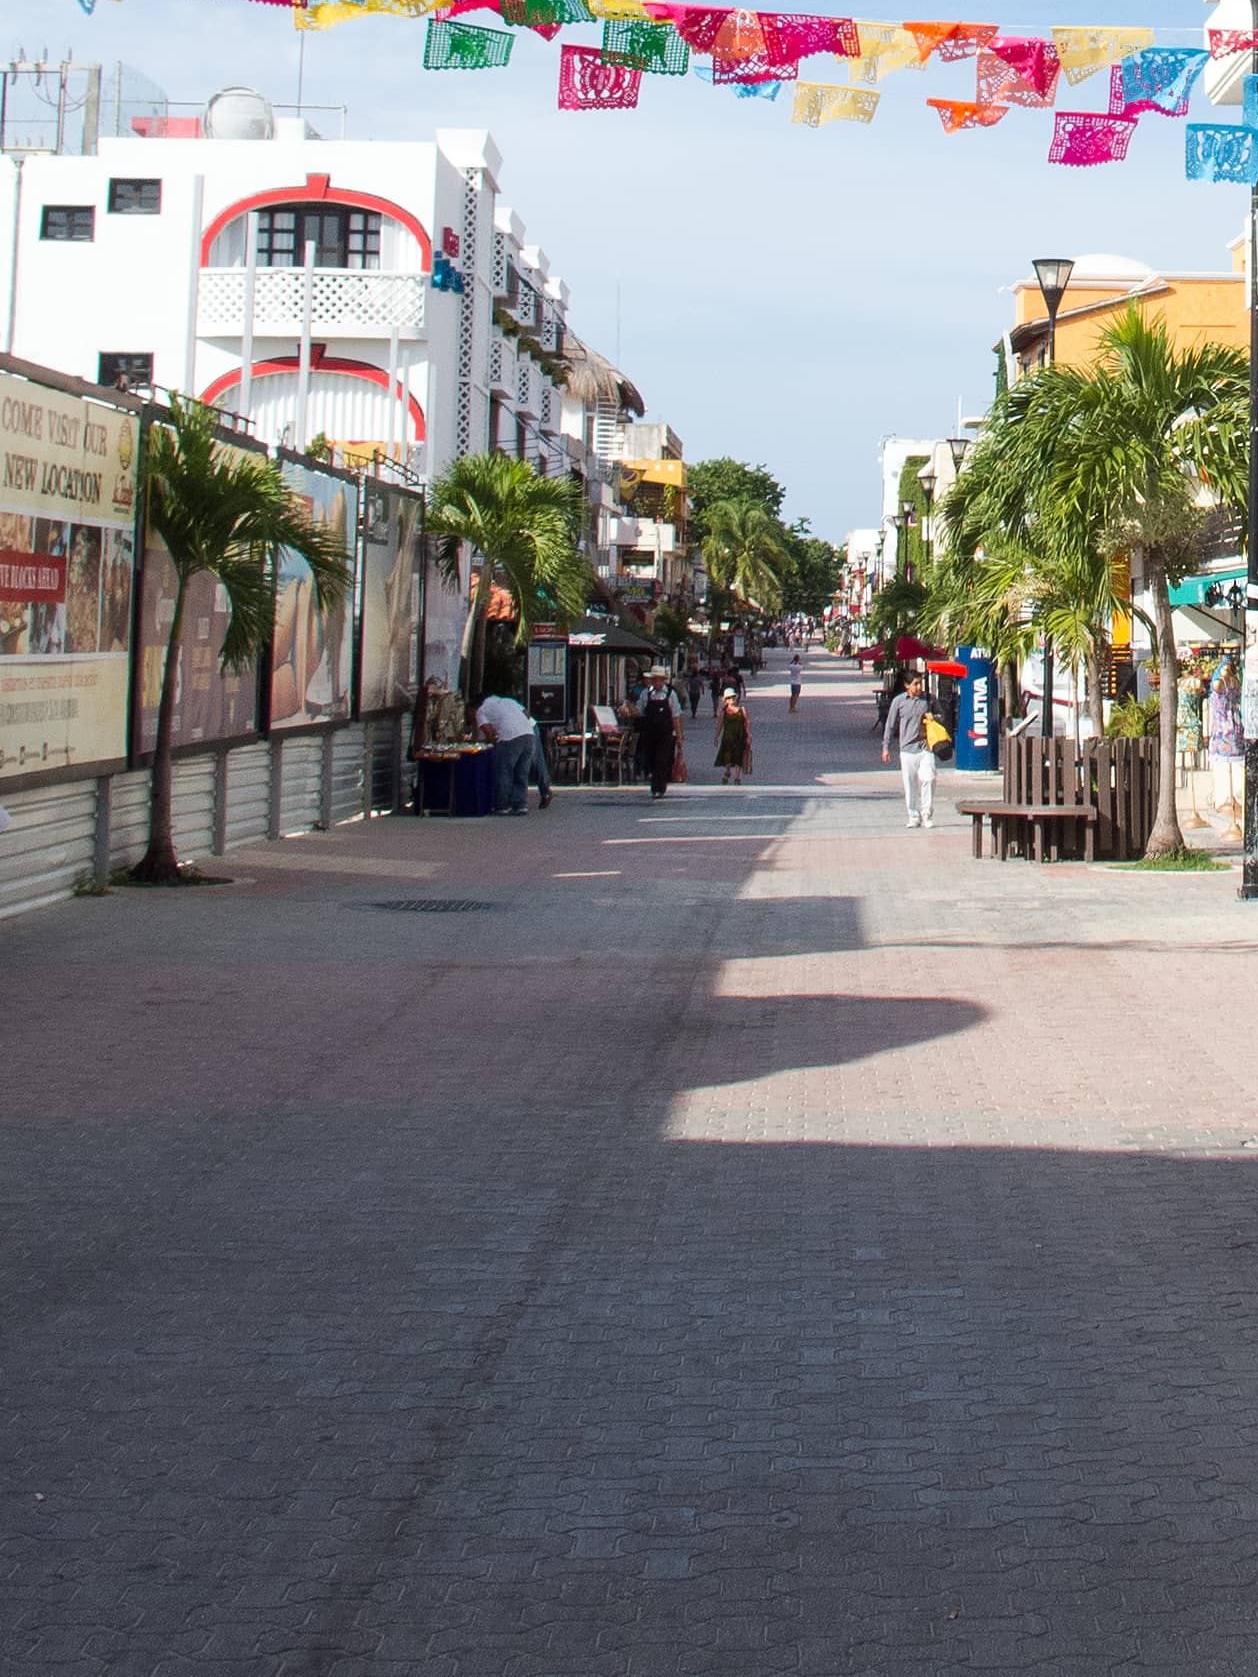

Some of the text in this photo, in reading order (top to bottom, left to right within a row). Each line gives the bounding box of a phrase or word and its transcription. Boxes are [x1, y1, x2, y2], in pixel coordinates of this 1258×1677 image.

[2, 395, 107, 457] COME VISIT OUR
[4, 452, 38, 491] NEW
[40, 462, 102, 504] LOCATION
